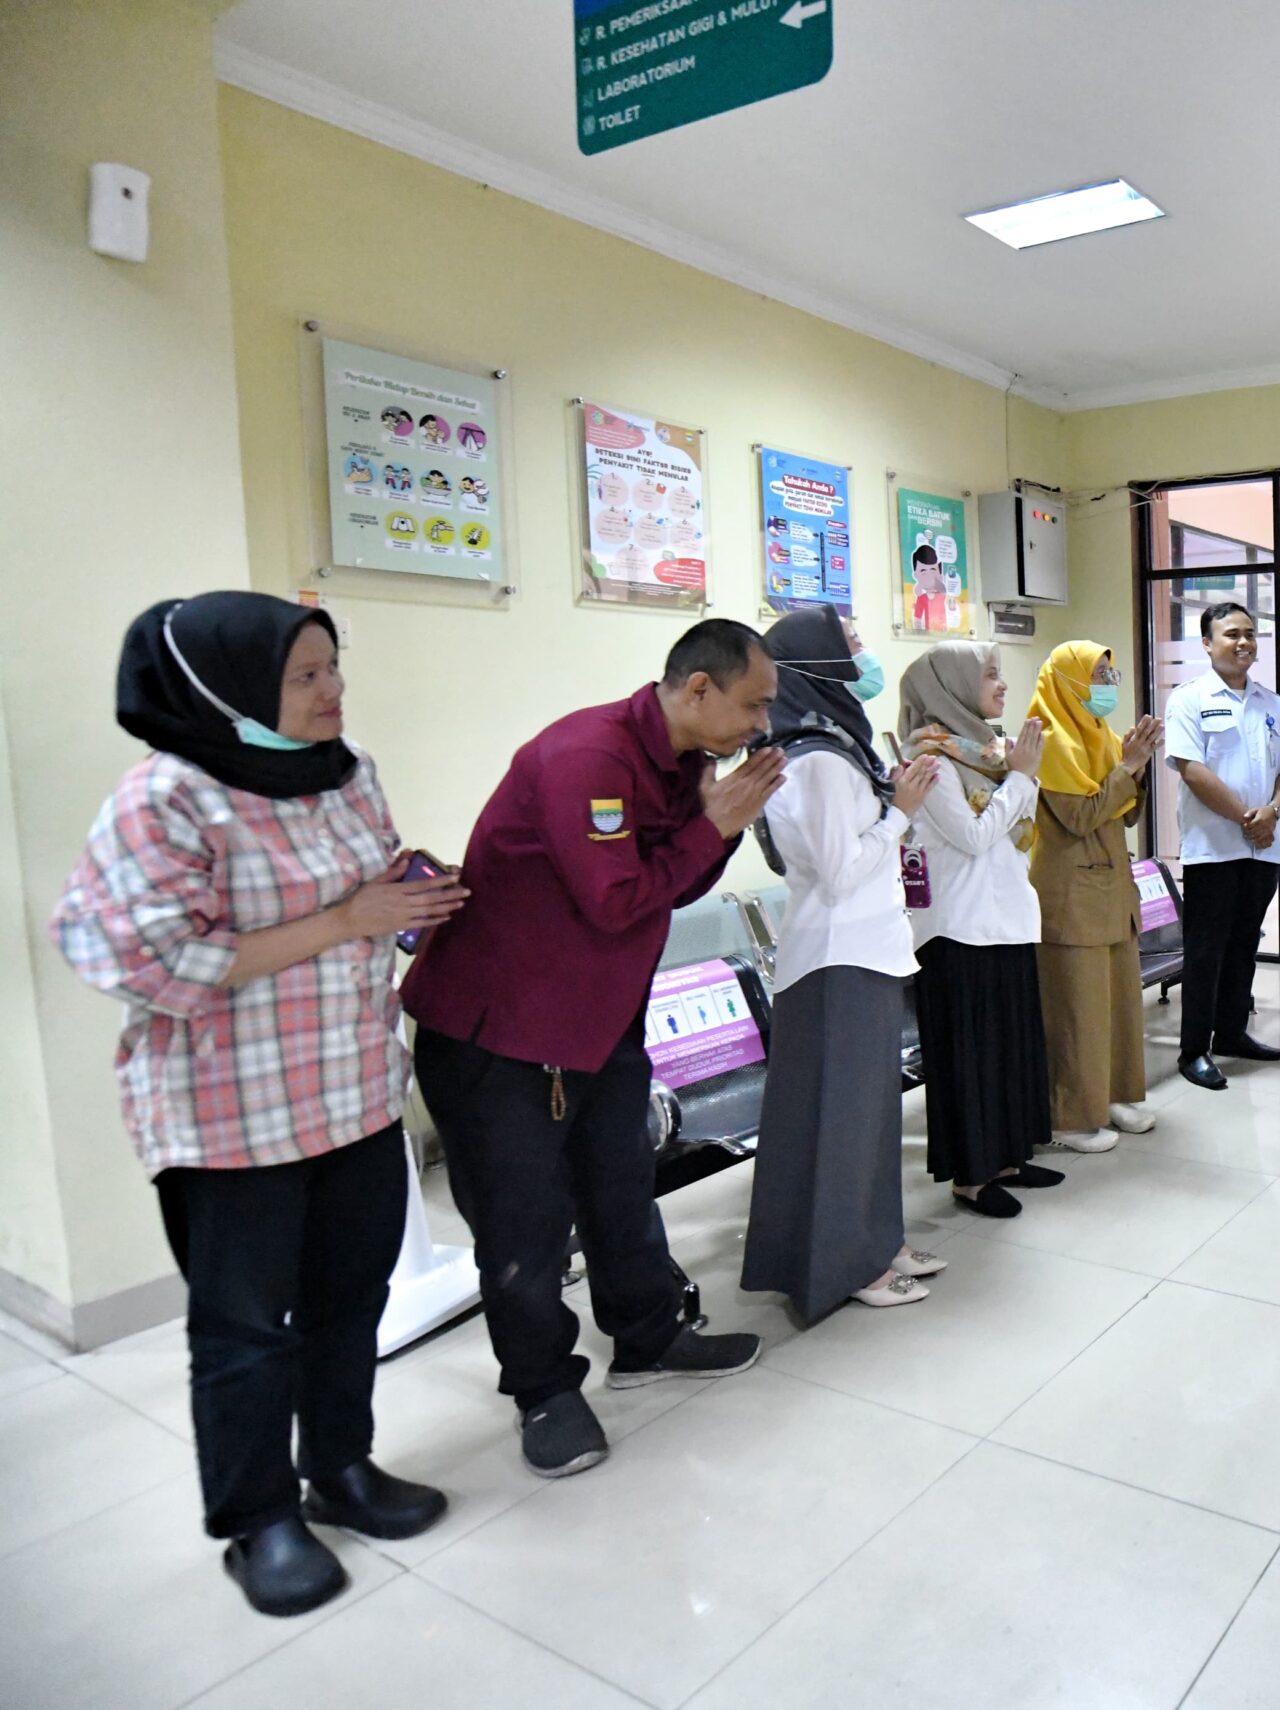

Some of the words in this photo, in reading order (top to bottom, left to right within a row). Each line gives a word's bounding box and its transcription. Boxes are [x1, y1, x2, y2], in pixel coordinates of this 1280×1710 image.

[610, 0, 698, 35] PEMERIKSA
[611, 26, 686, 65] KESEHATAN
[688, 15, 714, 36] GIGI
[718, 11, 727, 26] &
[598, 55, 696, 101] LABORATORIUM
[599, 105, 641, 131] TOILET
